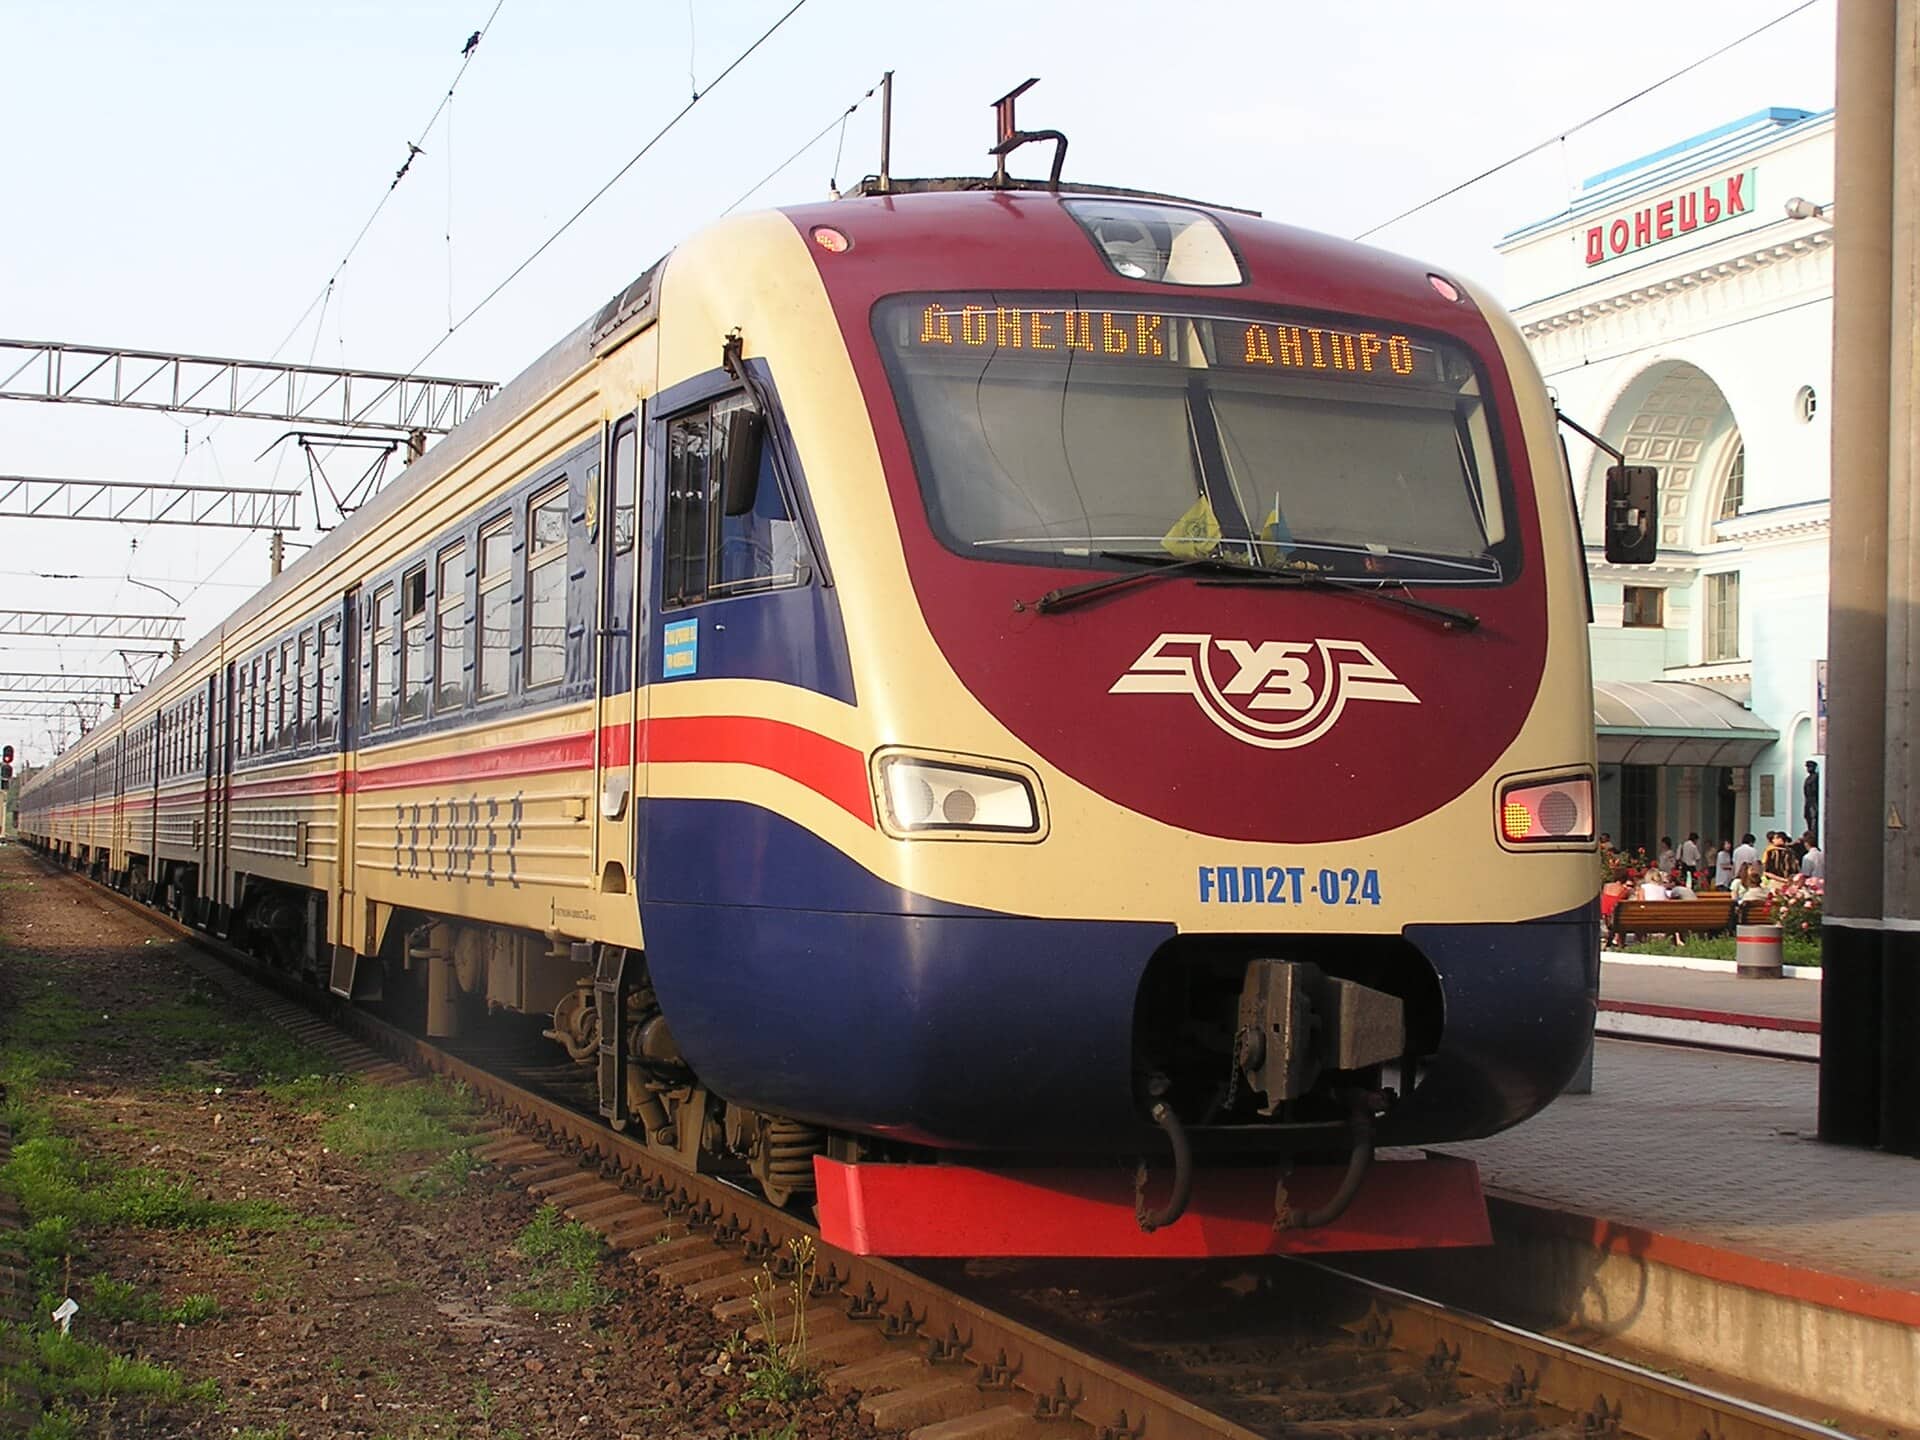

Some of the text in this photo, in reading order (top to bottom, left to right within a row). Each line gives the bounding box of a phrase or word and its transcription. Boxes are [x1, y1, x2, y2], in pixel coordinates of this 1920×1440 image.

[1585, 173, 1745, 265] ДОНЕЦЬК
[920, 303, 1413, 375] ДОНЕЦЬК ДНІПРО
